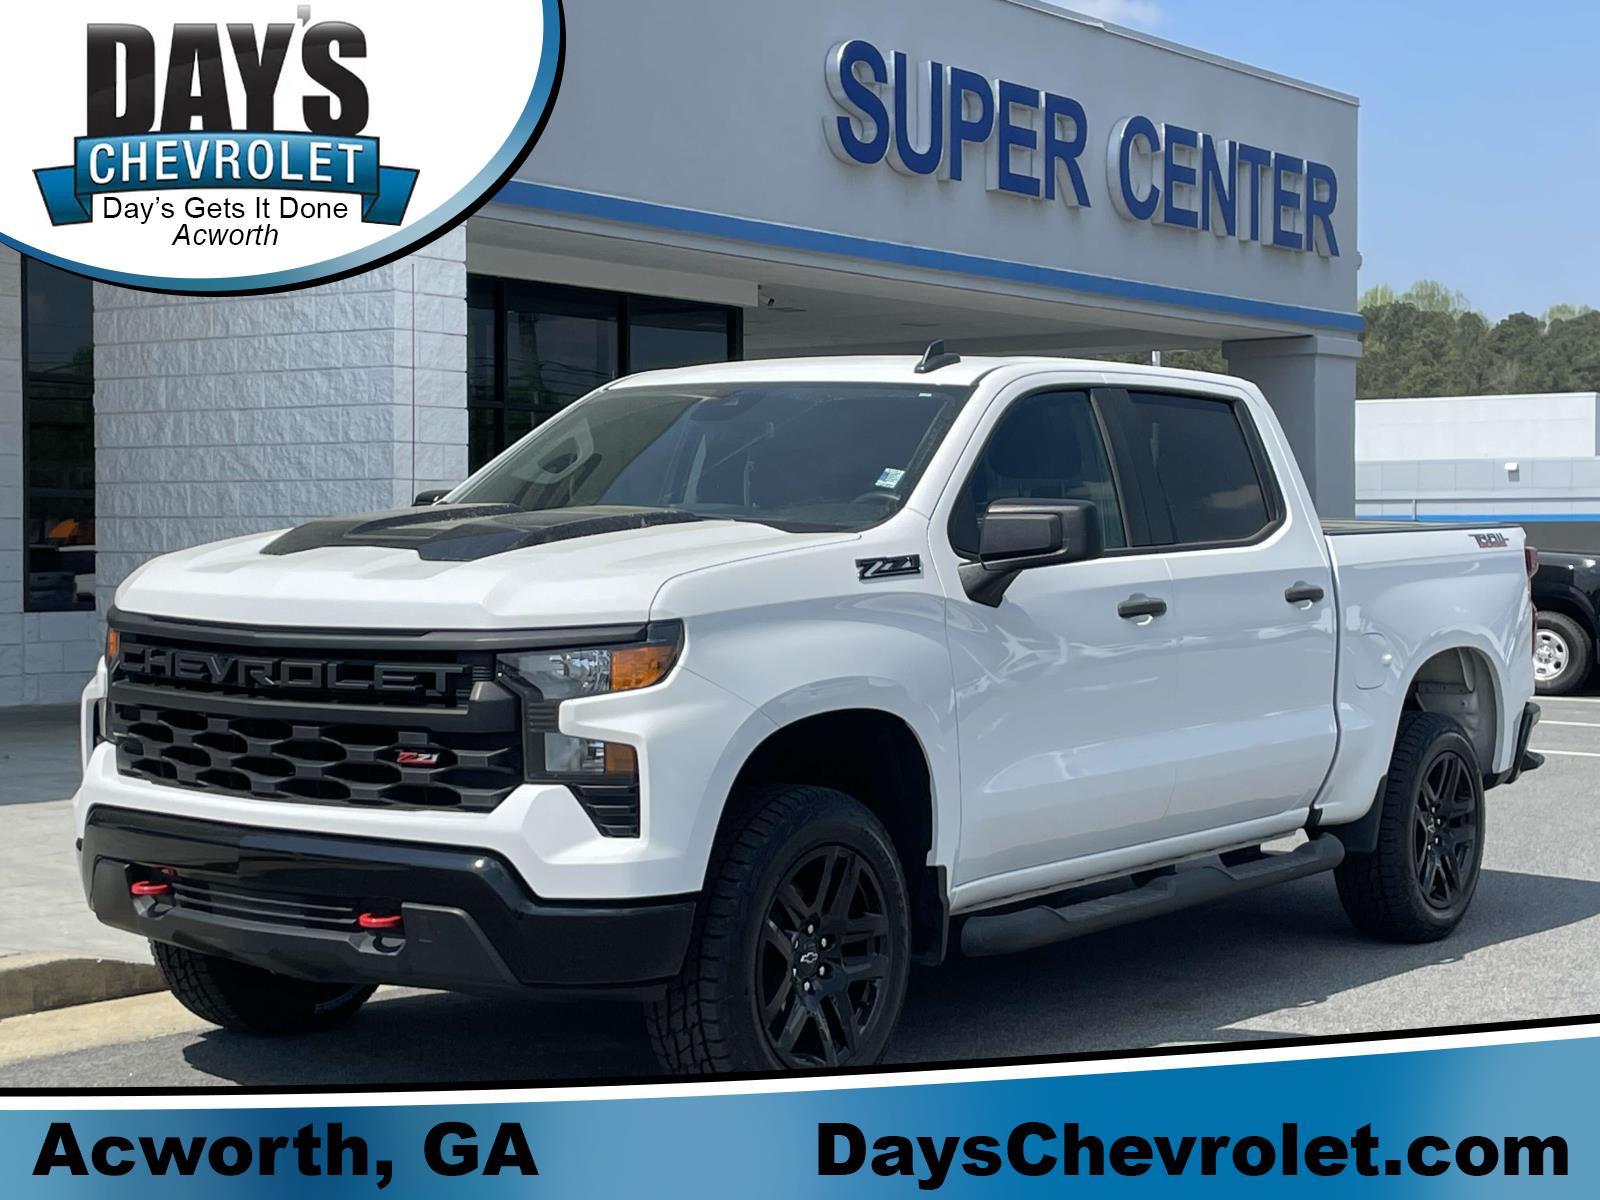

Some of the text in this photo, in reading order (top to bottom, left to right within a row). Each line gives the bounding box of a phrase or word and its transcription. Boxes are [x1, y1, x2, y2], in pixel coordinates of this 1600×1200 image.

[826, 40, 1340, 257] SUPER CENTER
[855, 554, 922, 581] Z71
[120, 646, 466, 696] CHEVROLET
